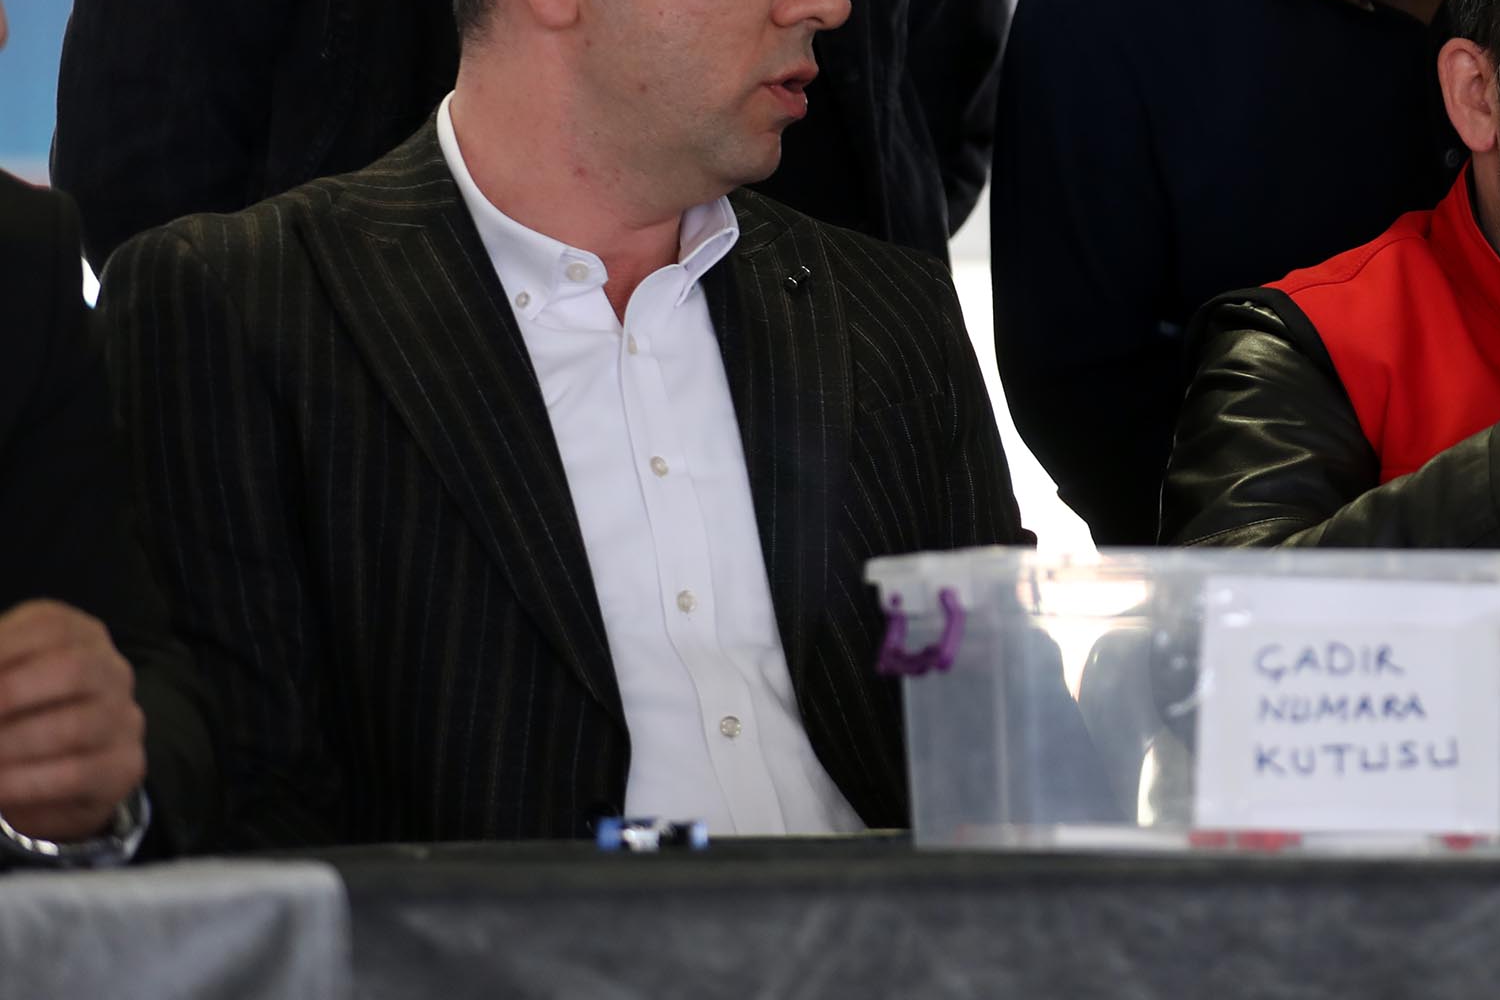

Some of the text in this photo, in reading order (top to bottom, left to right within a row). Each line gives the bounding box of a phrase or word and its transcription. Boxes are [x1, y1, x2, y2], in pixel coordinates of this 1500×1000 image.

[1254, 641, 1404, 682] ÇADIR
[1258, 693, 1426, 723] NUMARA
[1253, 737, 1459, 776] KUTUSU
